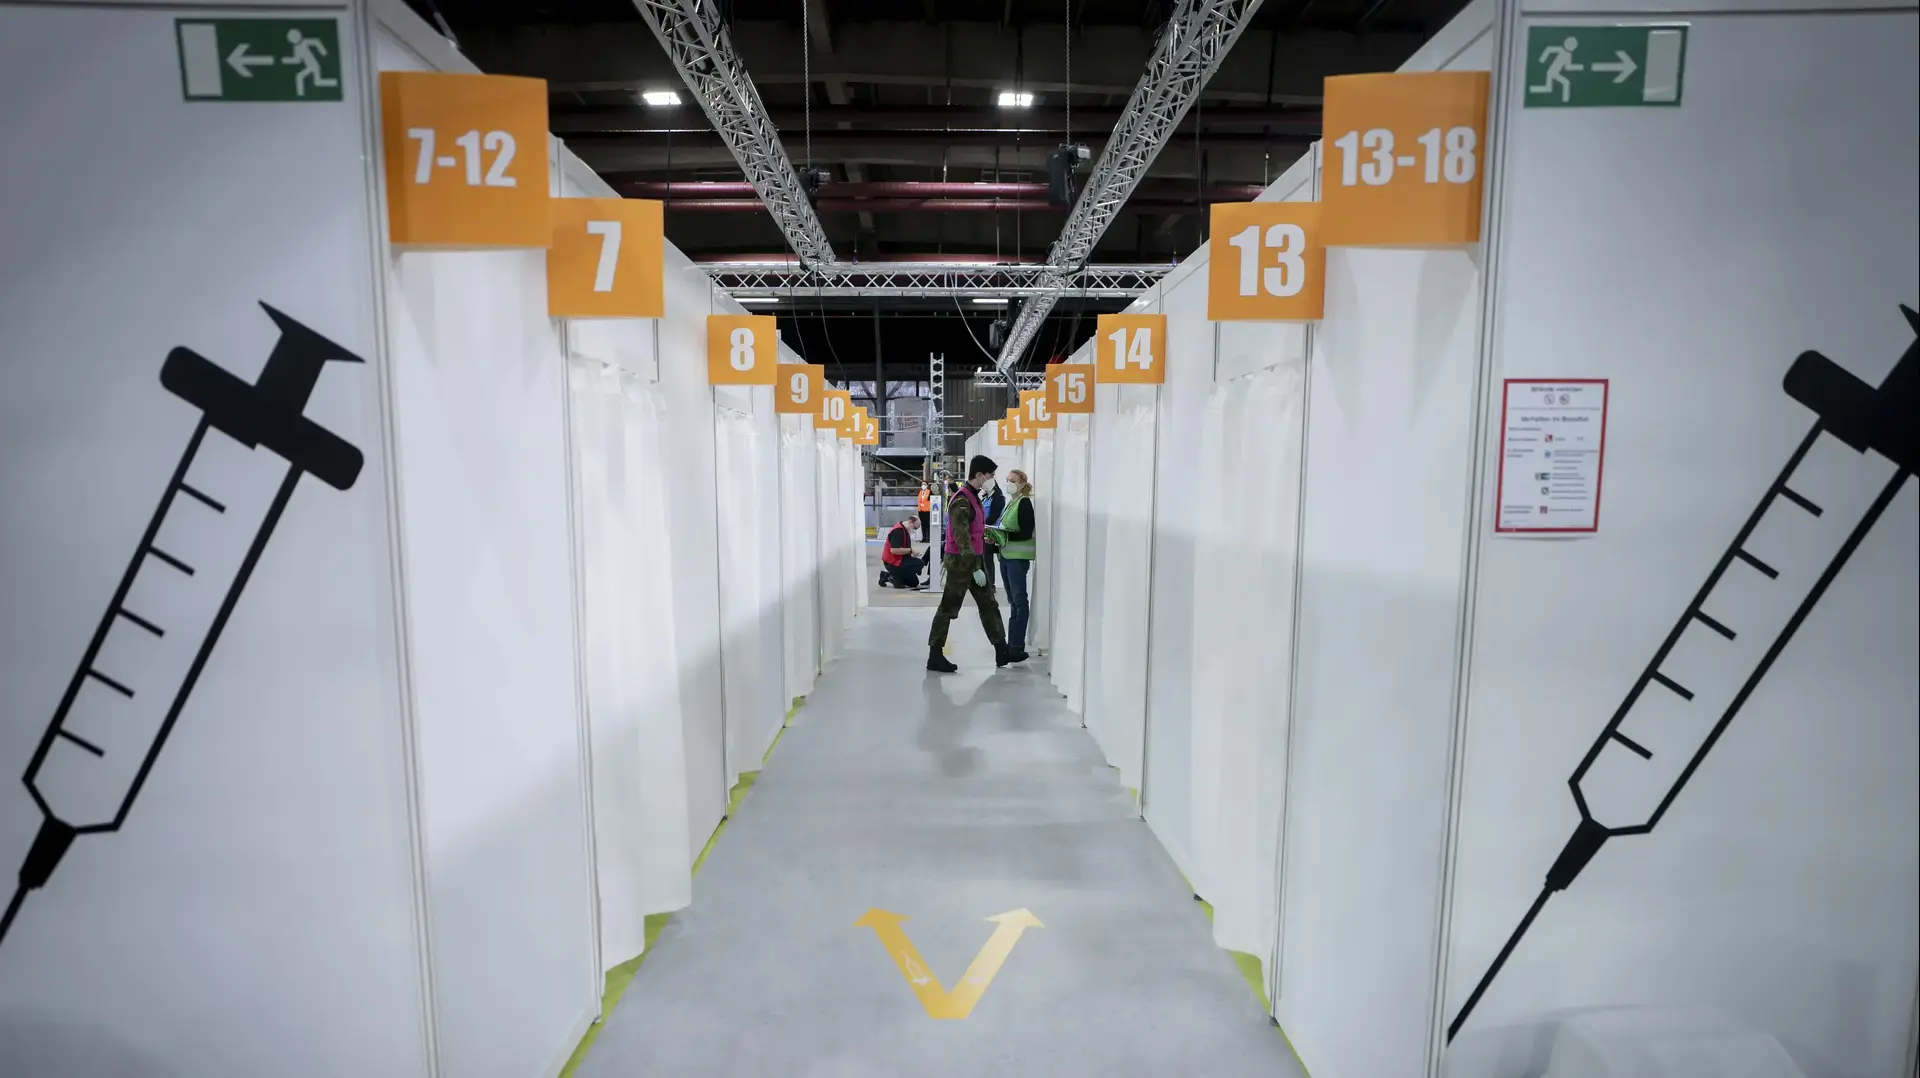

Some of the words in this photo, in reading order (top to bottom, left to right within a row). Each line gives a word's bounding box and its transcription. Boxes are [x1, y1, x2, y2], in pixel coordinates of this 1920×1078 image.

[408, 127, 516, 187] 7-12
[1334, 126, 1476, 187] 13-18
[587, 221, 621, 292] 7
[1229, 224, 1305, 298] 13
[730, 328, 755, 371] 8
[1108, 328, 1154, 370] 14
[790, 373, 809, 404] 9
[1053, 373, 1086, 404] 15
[823, 397, 844, 421] 10
[845, 412, 860, 432] 1
[1013, 414, 1029, 433] 1
[1025, 397, 1051, 421] 16
[860, 423, 875, 440] 2
